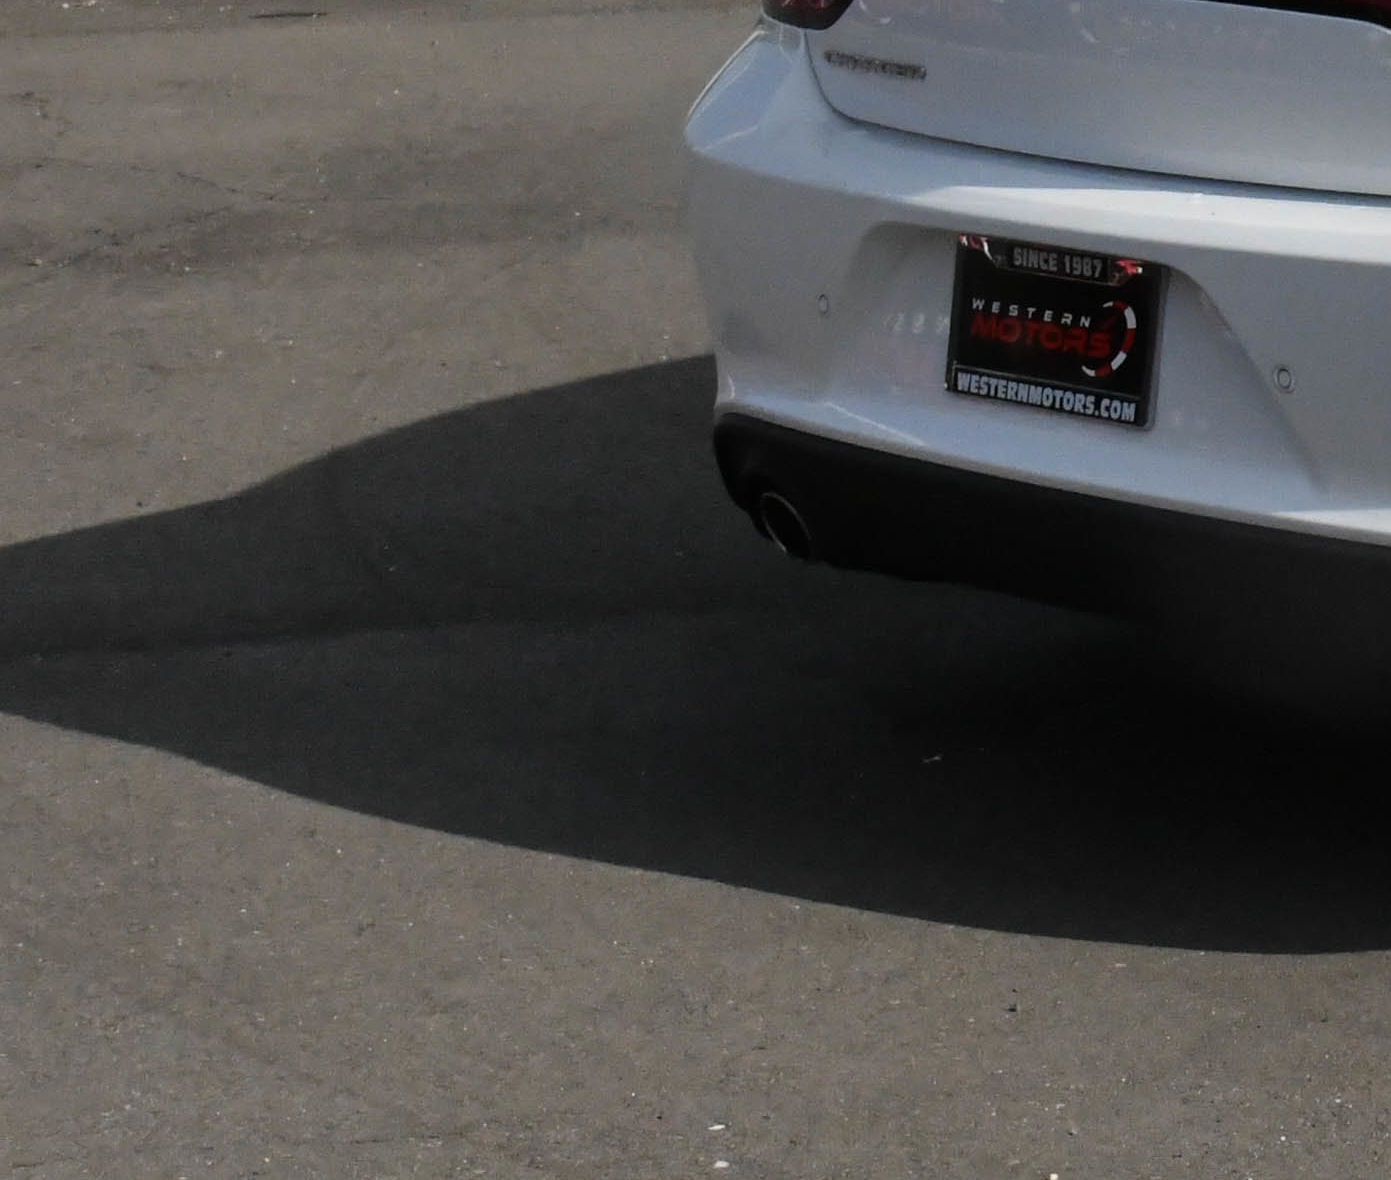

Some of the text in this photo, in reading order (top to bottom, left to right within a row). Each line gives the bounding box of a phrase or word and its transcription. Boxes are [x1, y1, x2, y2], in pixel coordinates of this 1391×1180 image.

[1013, 247, 1103, 277] SINCE 1987
[971, 297, 1092, 328] WESTERN
[970, 311, 1112, 358] MOTORS
[956, 372, 1137, 422] WESTERNMOTORS.COM
